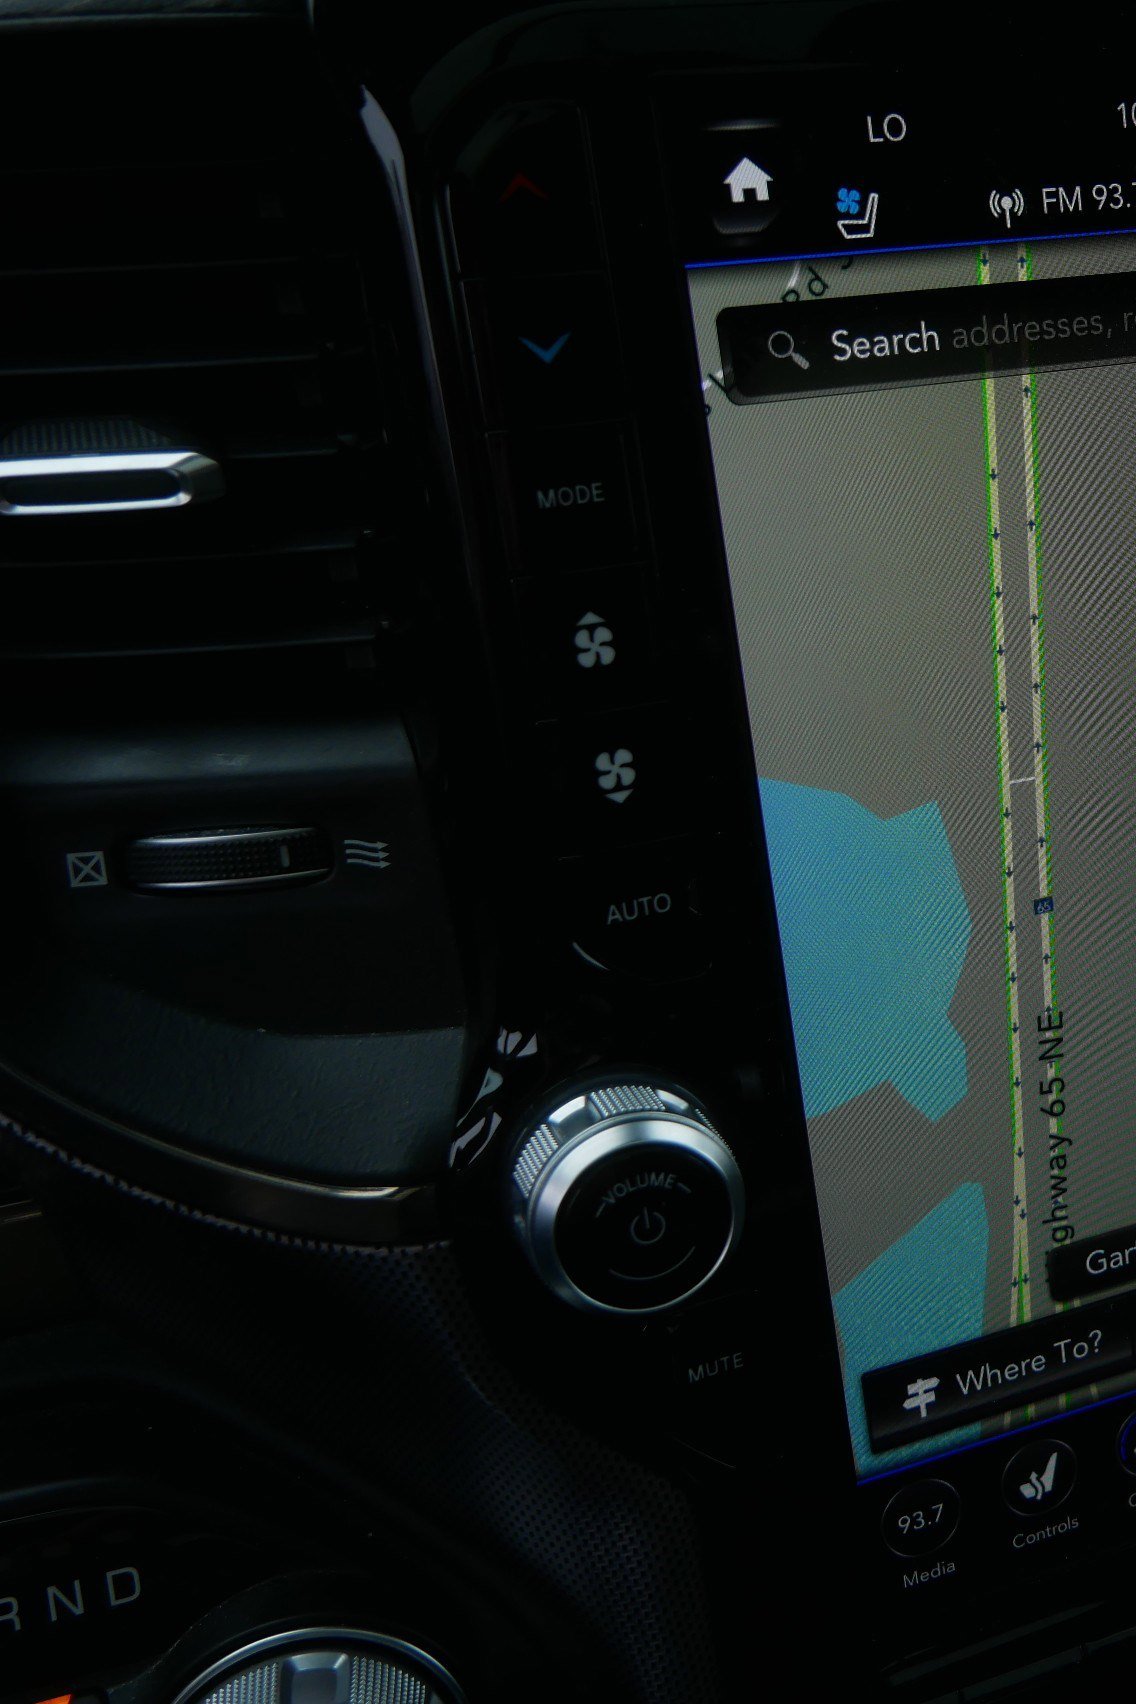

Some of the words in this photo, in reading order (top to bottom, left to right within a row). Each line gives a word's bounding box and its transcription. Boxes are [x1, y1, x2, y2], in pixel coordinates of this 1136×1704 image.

[867, 112, 907, 143] LO
[1042, 187, 1082, 215] FM
[831, 320, 941, 362] Search
[953, 313, 1113, 349] addresses,
[536, 481, 606, 511] MODE
[605, 893, 672, 926] AUTO
[1037, 1010, 1065, 1062] NE
[1039, 1076, 1066, 1118] 65
[602, 1171, 677, 1207] VOLUME
[1042, 1134, 1074, 1244] ghway
[688, 1352, 745, 1384] MUTE
[955, 1353, 1047, 1396] Where
[1054, 1329, 1102, 1365] To?
[897, 1503, 945, 1535] 93.7
[1012, 1515, 1080, 1550] Controls
[902, 1560, 956, 1590] Media
[45, 1579, 86, 1623] N
[104, 1566, 143, 1608] D
